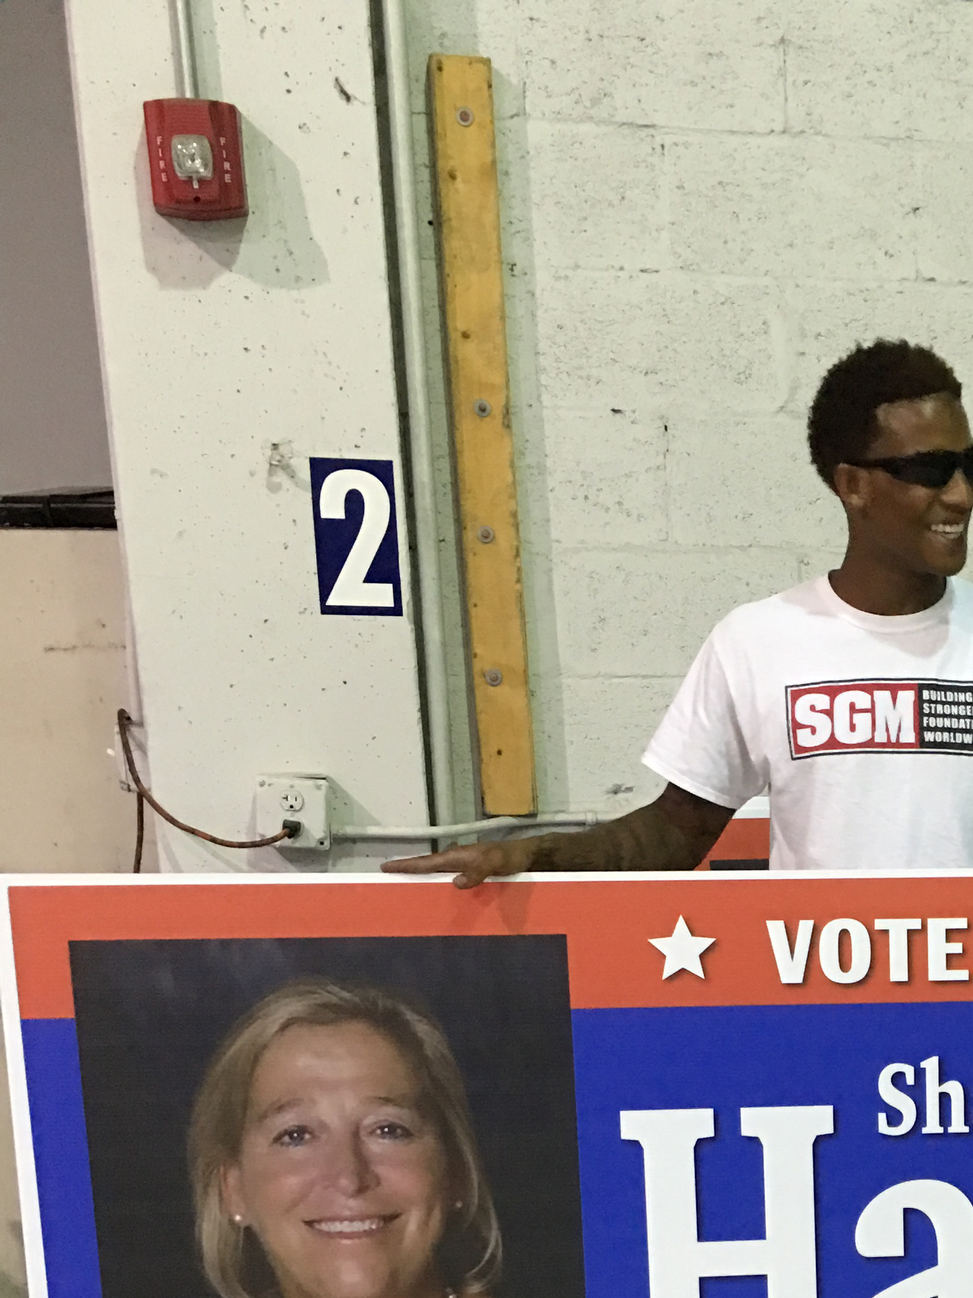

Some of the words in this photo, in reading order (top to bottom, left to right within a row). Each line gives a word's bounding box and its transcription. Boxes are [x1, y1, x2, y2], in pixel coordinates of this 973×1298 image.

[156, 136, 168, 182] FIRE
[220, 136, 232, 183] FIRE
[319, 468, 395, 608] 2
[794, 689, 917, 748] SGM
[922, 690, 973, 703] BUILDING
[766, 917, 969, 984] VOTE
